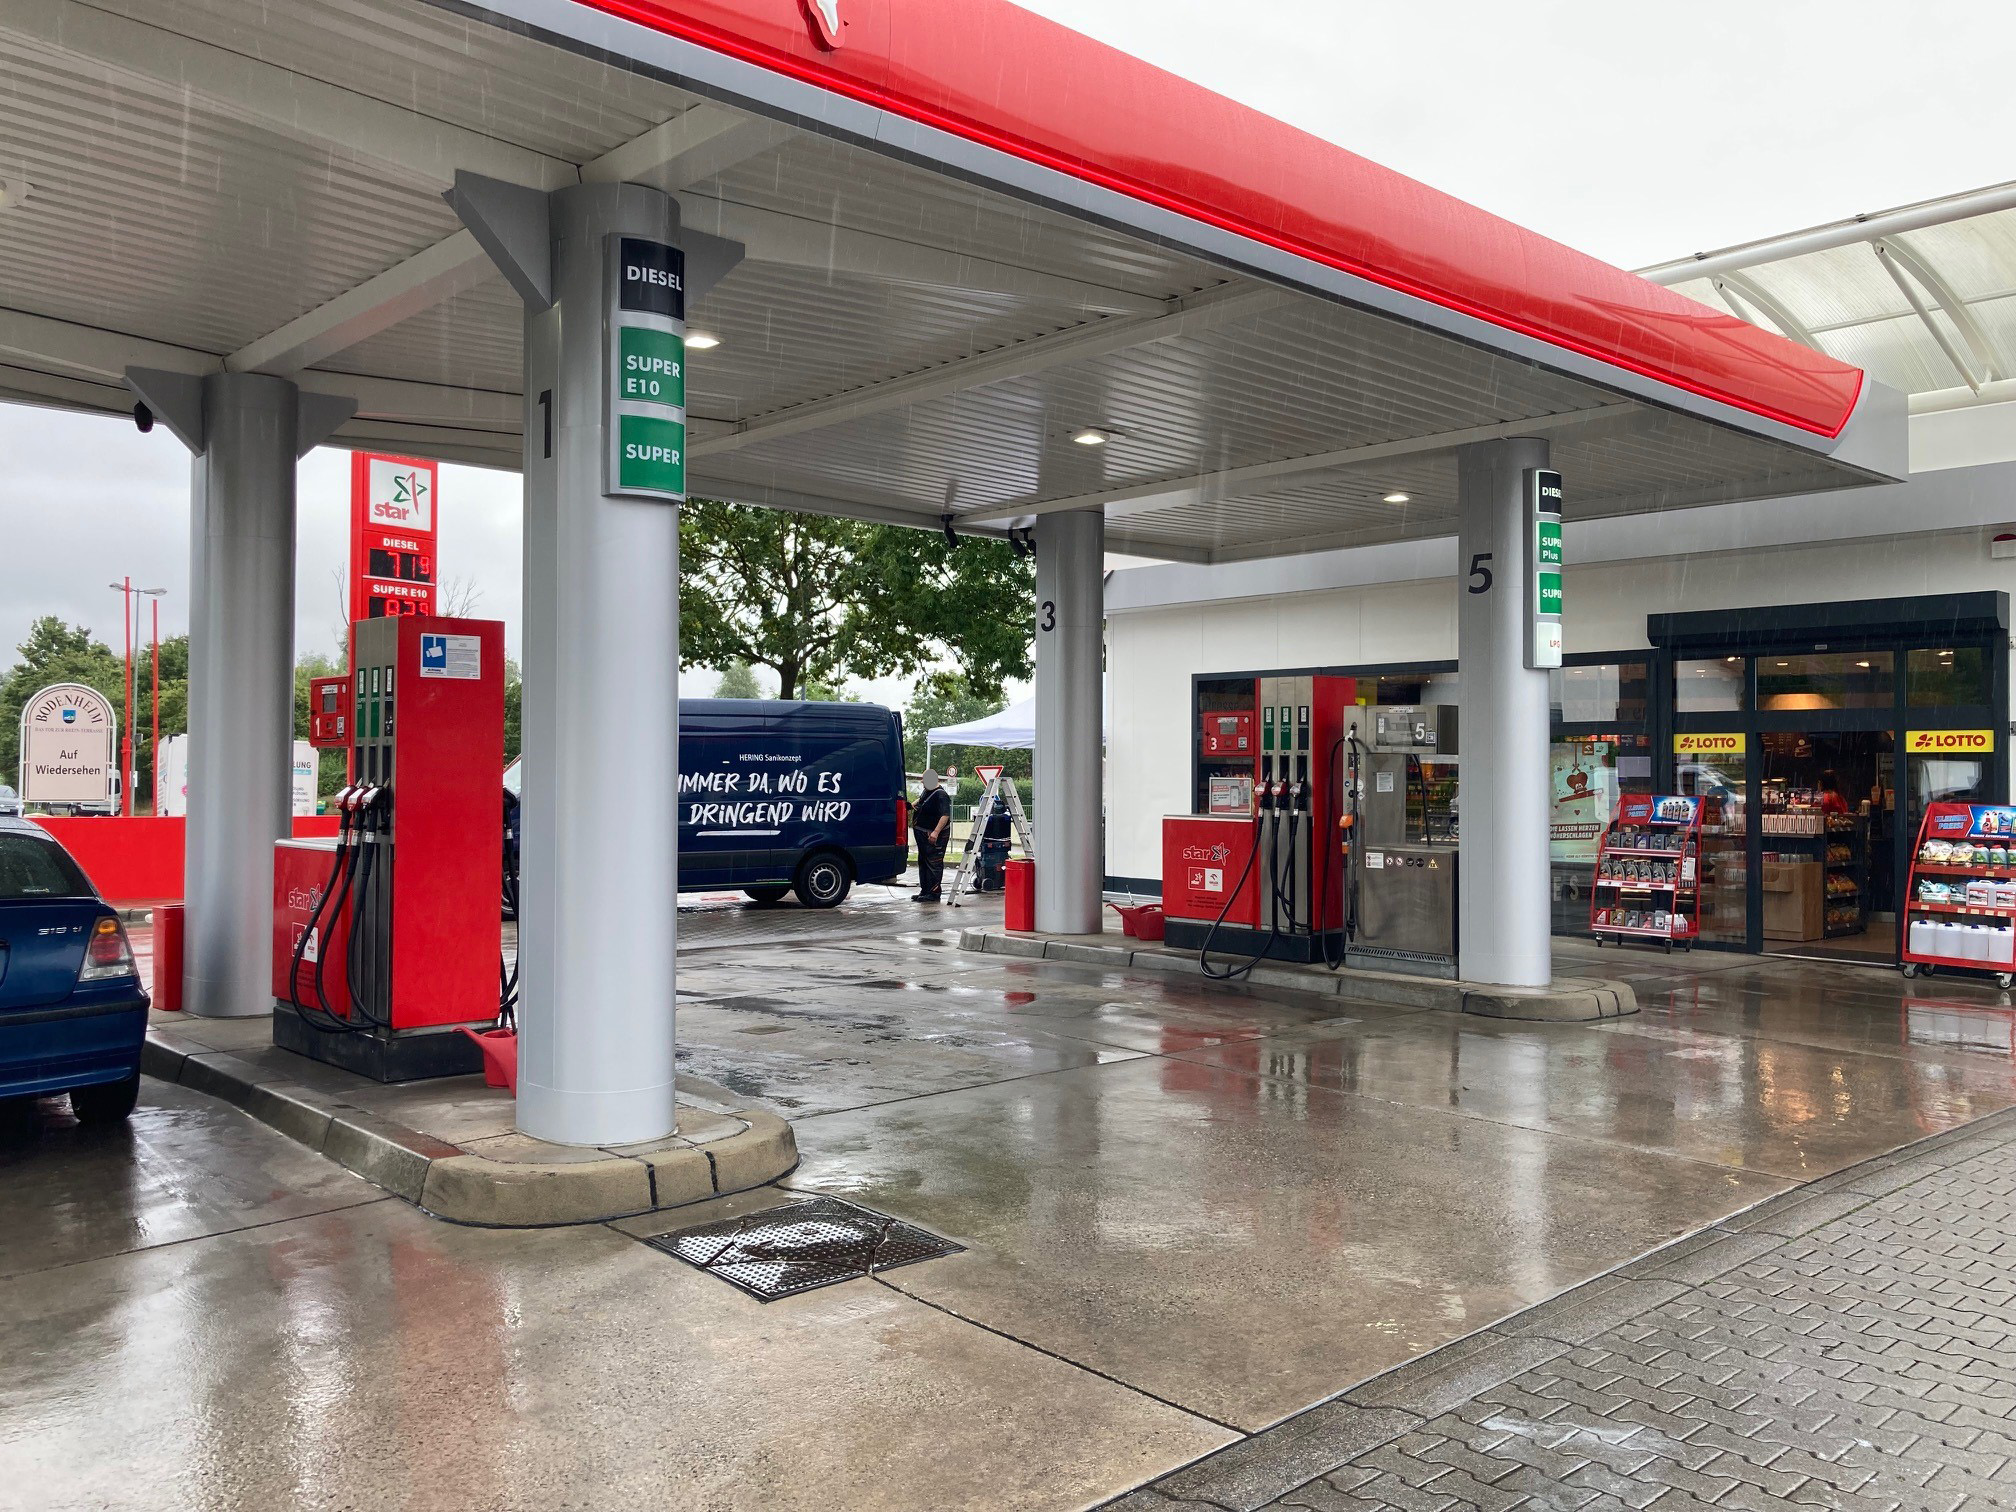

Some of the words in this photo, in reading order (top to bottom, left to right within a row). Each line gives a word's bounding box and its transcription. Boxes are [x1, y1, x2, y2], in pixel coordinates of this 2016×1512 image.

[626, 265, 683, 292] DIESEL
[626, 354, 681, 379] SUPER
[626, 377, 660, 396] E10
[538, 388, 552, 460] 1
[625, 443, 680, 466] SUPER
[373, 501, 410, 521] star
[383, 537, 419, 551] DIESEL
[1467, 552, 1493, 595] 5
[372, 583, 408, 596] SUPER
[410, 588, 428, 599] E10
[1040, 600, 1056, 632] 3
[1549, 639, 1561, 648] LPG
[36, 694, 103, 724] BODENHEIM
[315, 717, 320, 737] 1
[1414, 722, 1426, 740] 5
[1210, 737, 1218, 751] 3
[1696, 737, 1737, 748] LOTTO
[1936, 734, 1986, 747] LOTTO
[59, 749, 78, 760] Auf
[739, 753, 764, 762] HERING
[765, 754, 802, 763] Sanikonzept
[36, 764, 101, 775] Wiedersehen
[678, 771, 741, 793] IMMER
[747, 772, 773, 795] DA,
[777, 770, 808, 794] WO
[818, 771, 843, 794] ES
[1182, 844, 1211, 861] star
[288, 886, 310, 911] star
